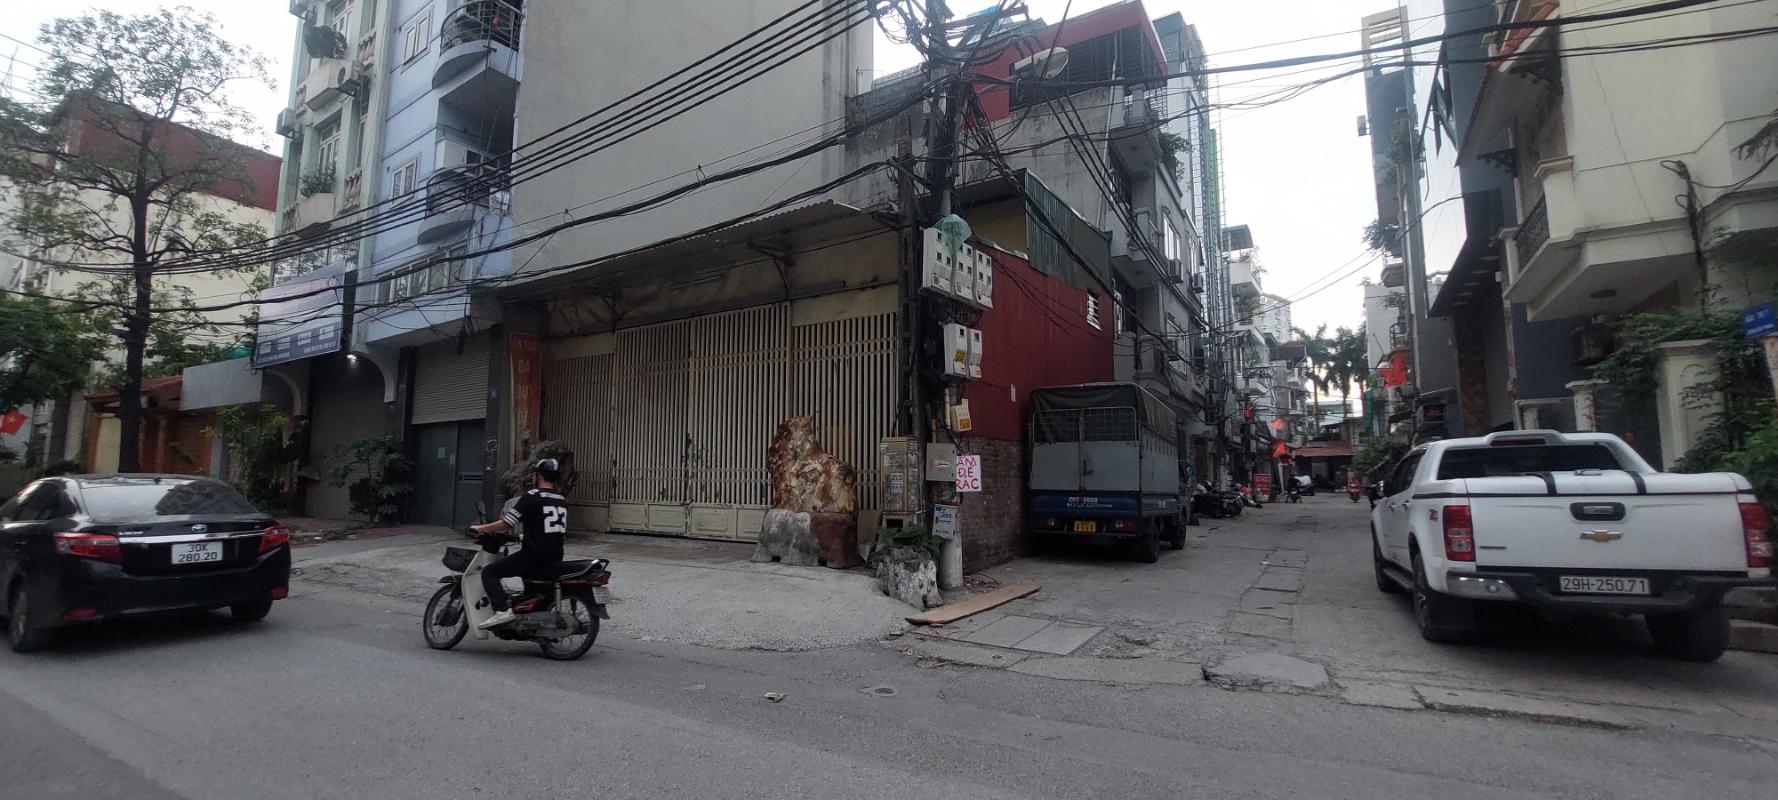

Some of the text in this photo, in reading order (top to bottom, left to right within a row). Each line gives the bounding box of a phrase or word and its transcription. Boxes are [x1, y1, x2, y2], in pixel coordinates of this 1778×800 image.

[542, 505, 568, 534] 23
[187, 543, 209, 553] 30K
[178, 552, 218, 562] 280.20
[1562, 577, 1646, 593] 29H-250.71
